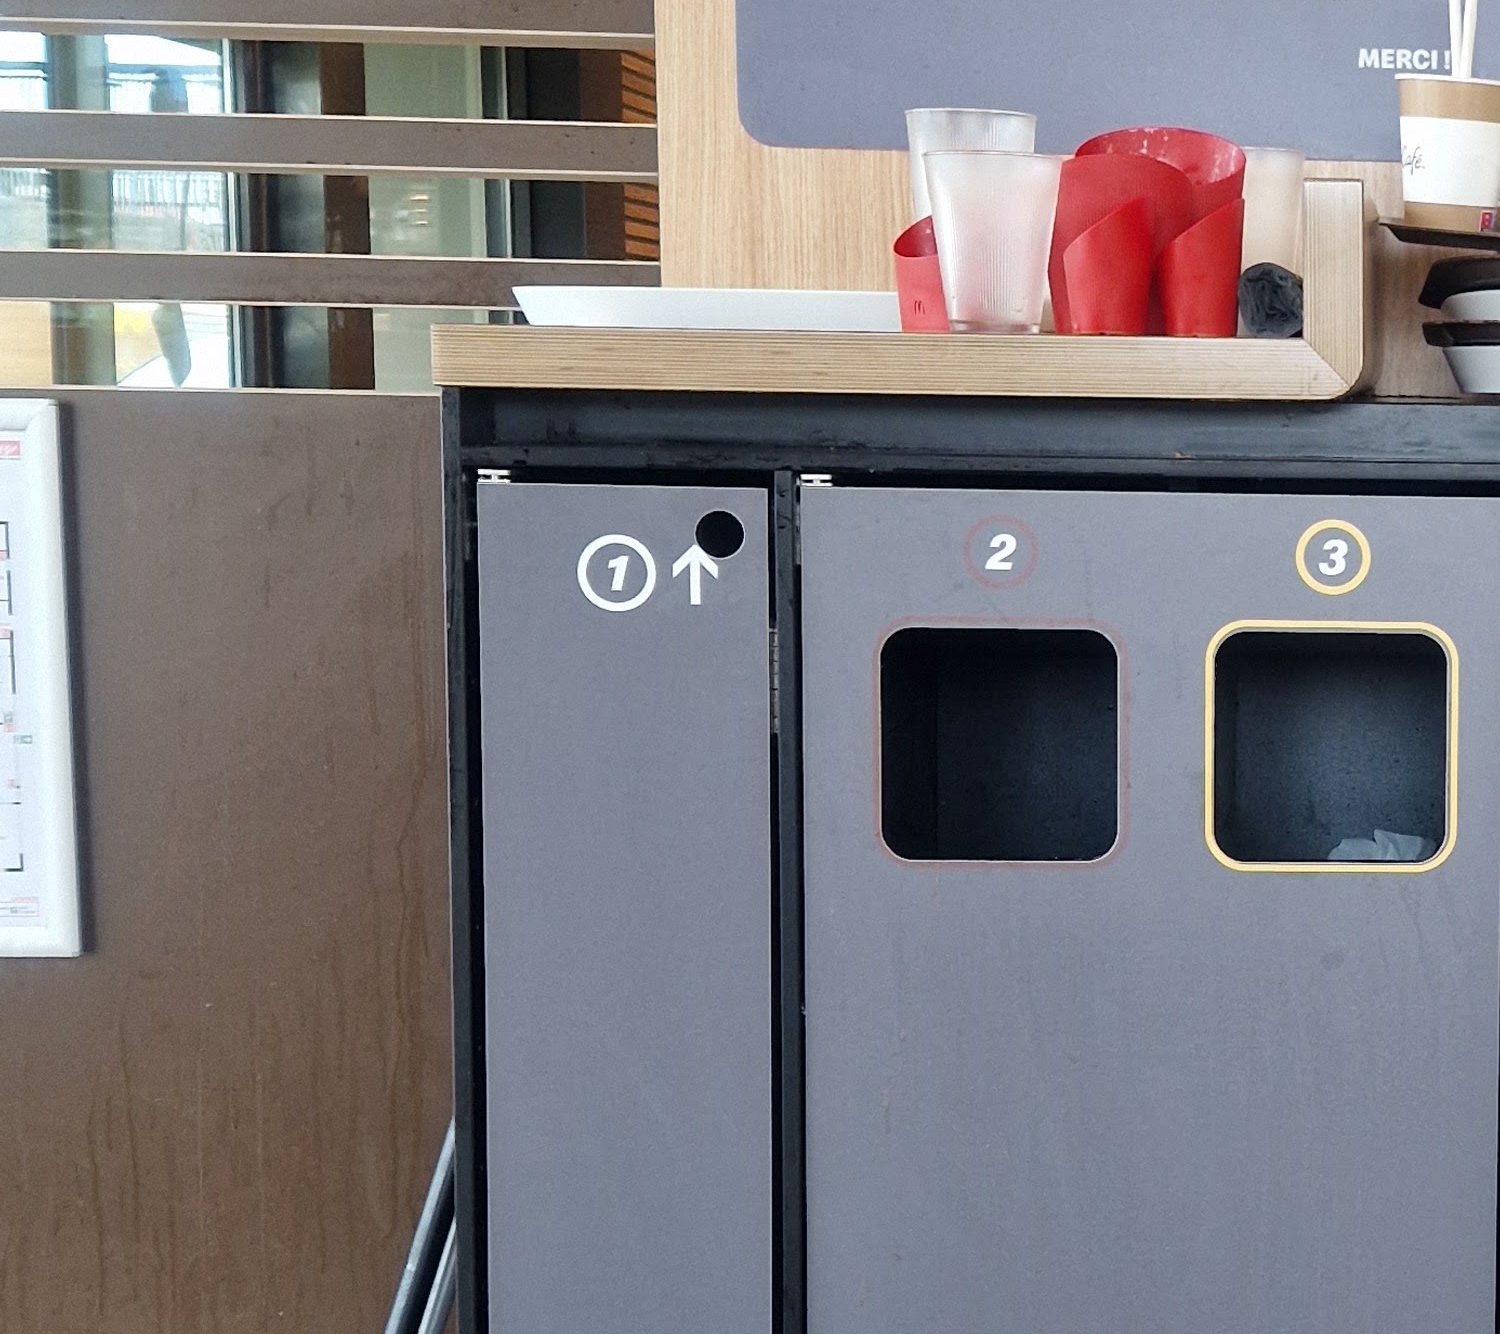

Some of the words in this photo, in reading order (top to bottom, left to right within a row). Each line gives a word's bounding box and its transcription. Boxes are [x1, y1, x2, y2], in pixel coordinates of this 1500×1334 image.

[1359, 48, 1437, 69] MERCI
[985, 534, 1016, 570] 2
[1319, 539, 1348, 575] 3
[608, 556, 629, 590] 1
